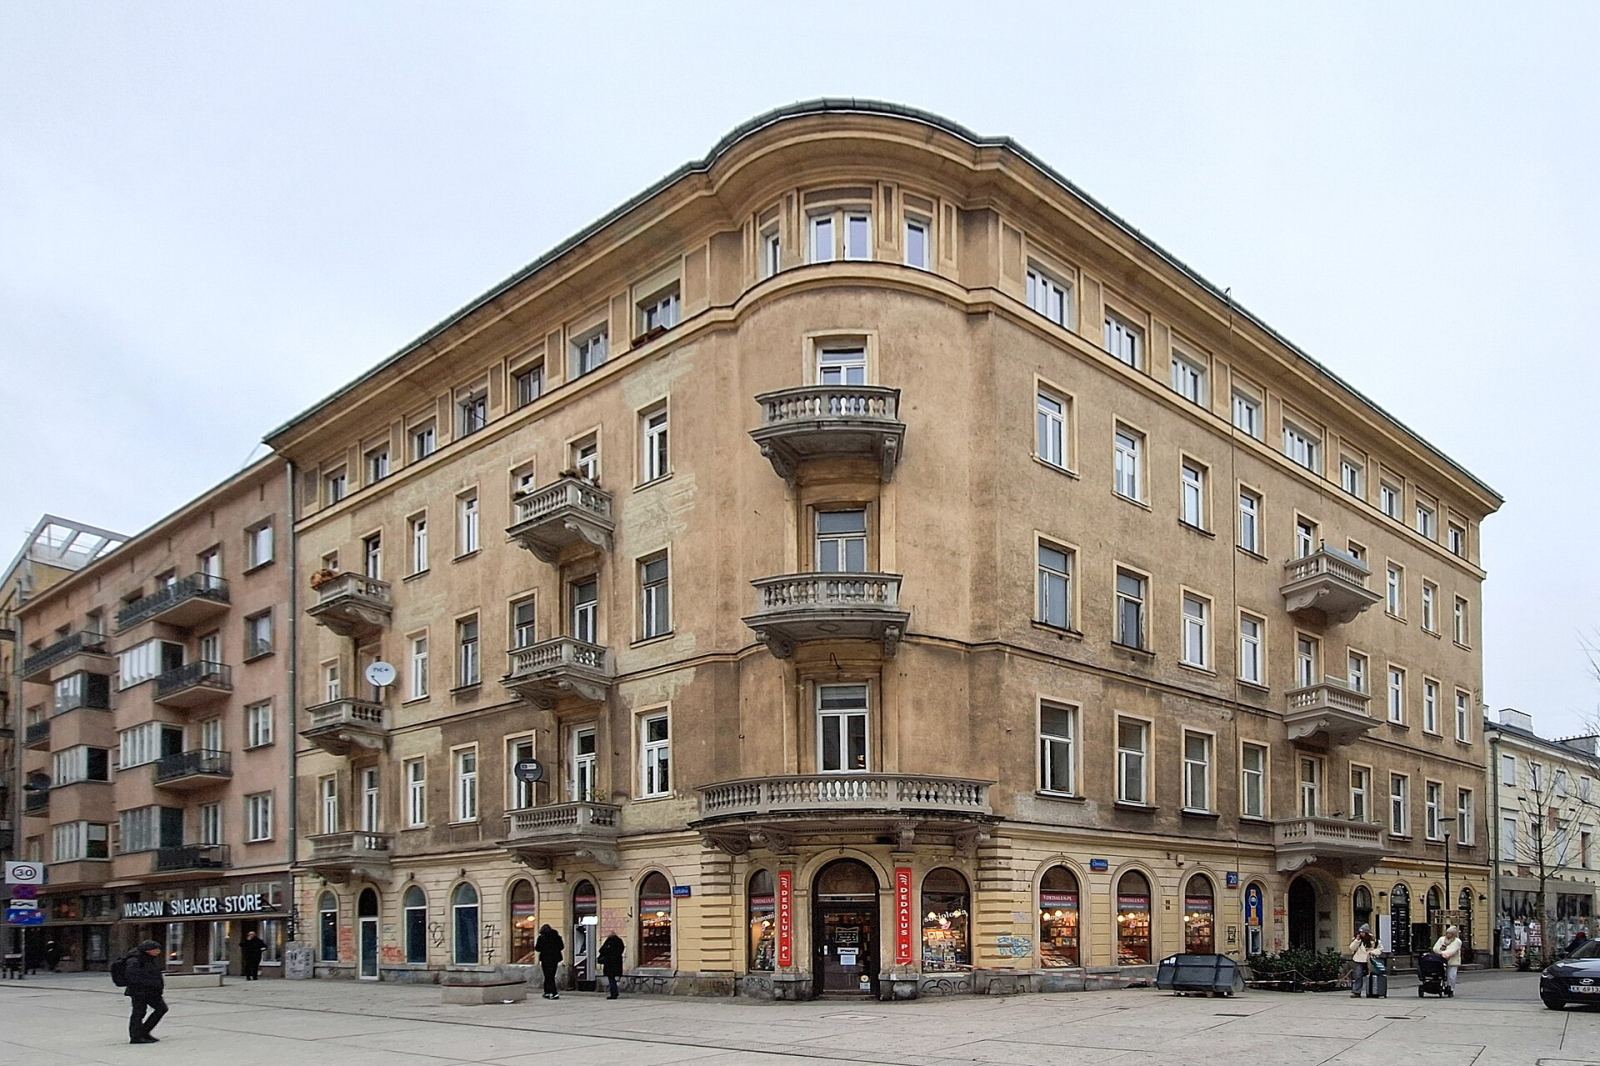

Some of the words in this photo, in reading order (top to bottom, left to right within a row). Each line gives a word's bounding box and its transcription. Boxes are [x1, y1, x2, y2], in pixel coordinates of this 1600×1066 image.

[16, 868, 33, 877] 30
[124, 901, 164, 917] WARSAW
[171, 897, 218, 915] SNEAKER
[224, 894, 262, 913] STORE
